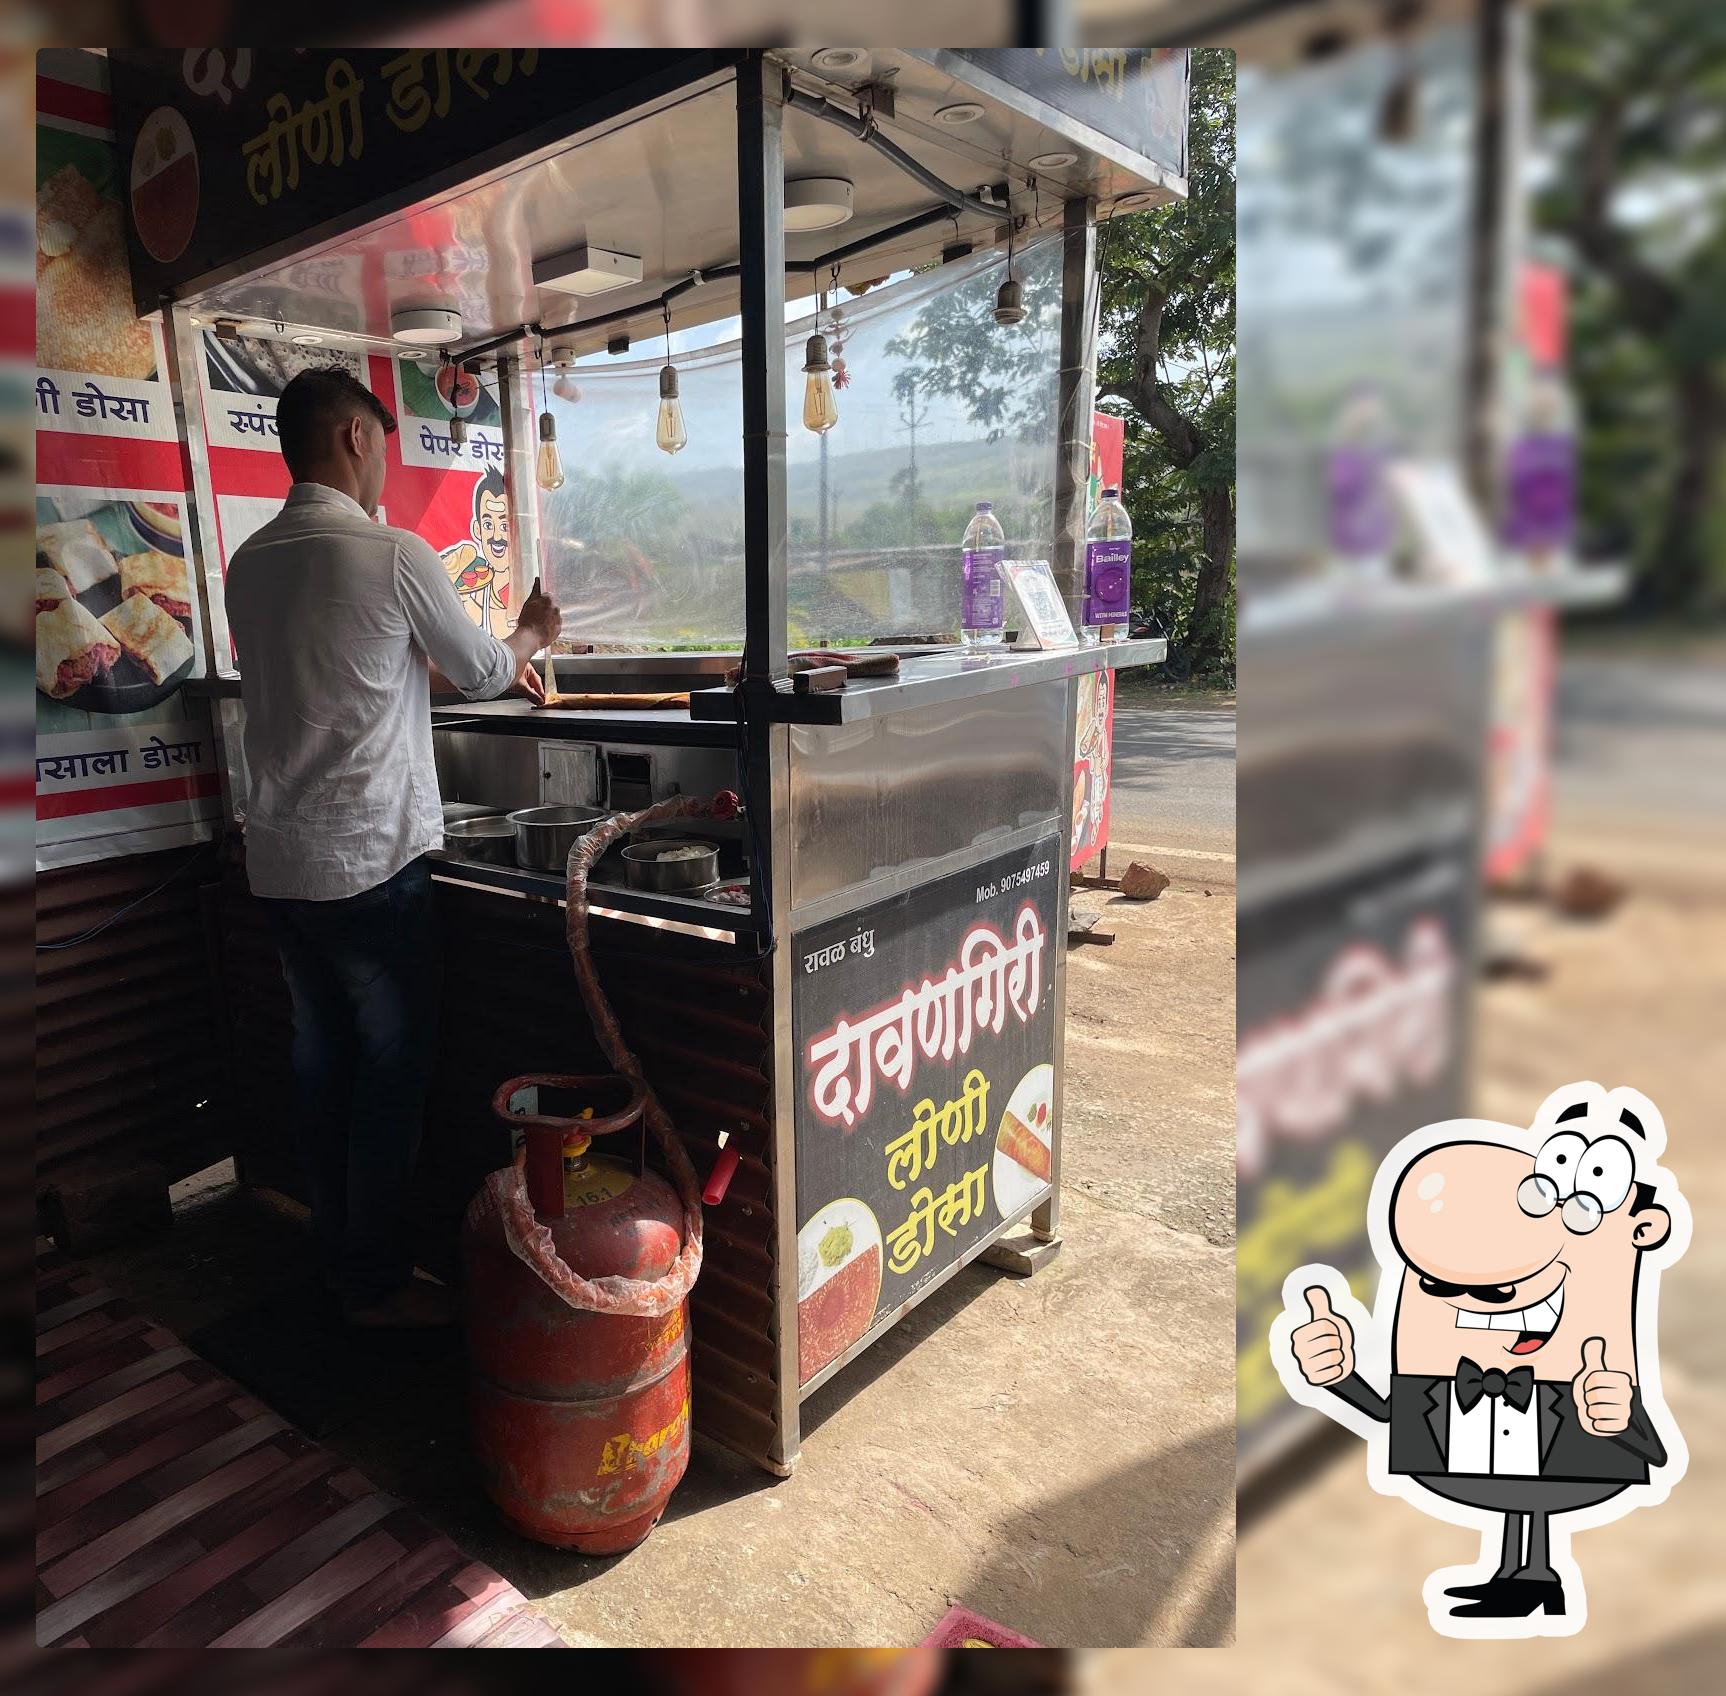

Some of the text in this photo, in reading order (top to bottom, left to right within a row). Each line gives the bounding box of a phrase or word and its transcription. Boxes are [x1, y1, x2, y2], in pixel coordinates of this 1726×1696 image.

[241, 58, 365, 206] लोणी
[72, 382, 150, 424] डोसा
[470, 432, 504, 461] डोस
[140, 736, 202, 769] डोसा
[976, 861, 1051, 904] Mob. 9075497459
[803, 926, 876, 974] रावळ बंधु
[811, 907, 1045, 1127] दावणगिरी
[885, 1068, 991, 1191] लोणी
[886, 1162, 989, 1275] डोसा
